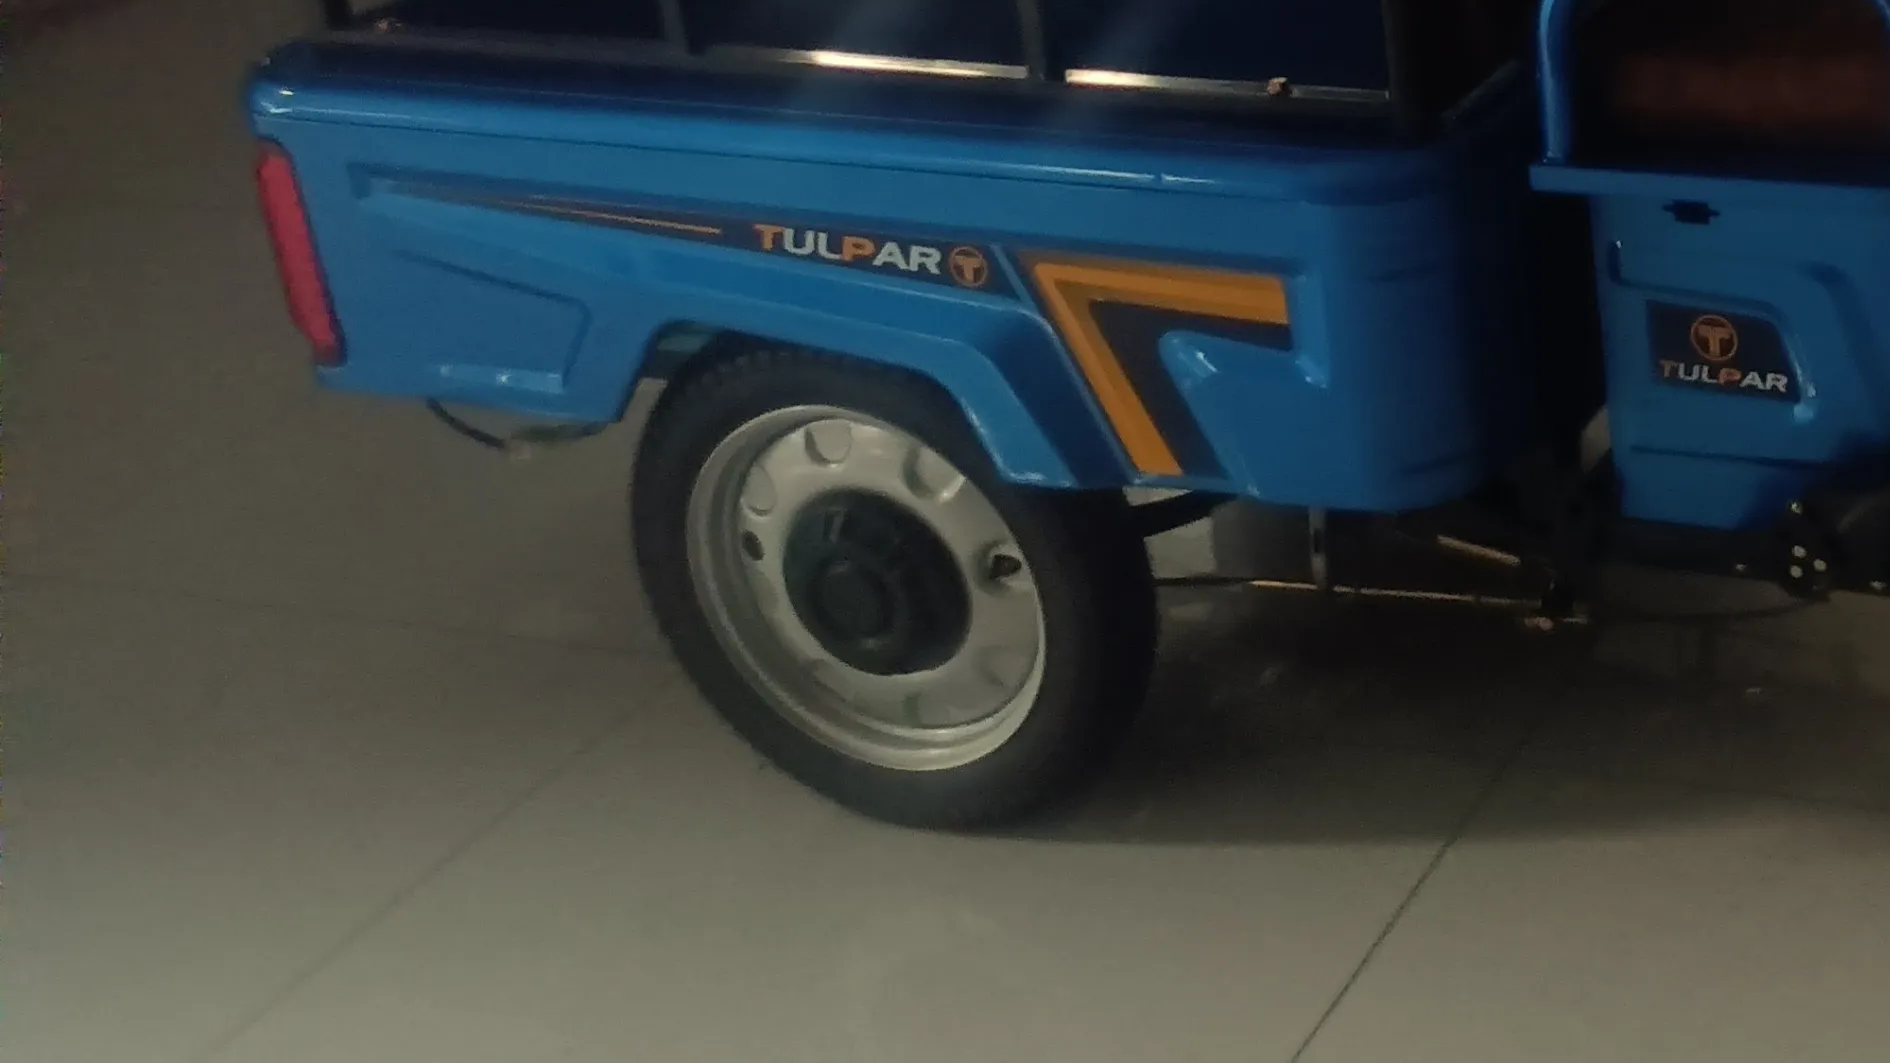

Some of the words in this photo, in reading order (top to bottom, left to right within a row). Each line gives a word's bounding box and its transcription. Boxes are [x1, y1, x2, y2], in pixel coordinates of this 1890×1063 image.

[753, 223, 942, 275] TULPAR
[952, 253, 984, 283] T
[1699, 323, 1733, 357] T
[1660, 360, 1789, 393] TULPAR
